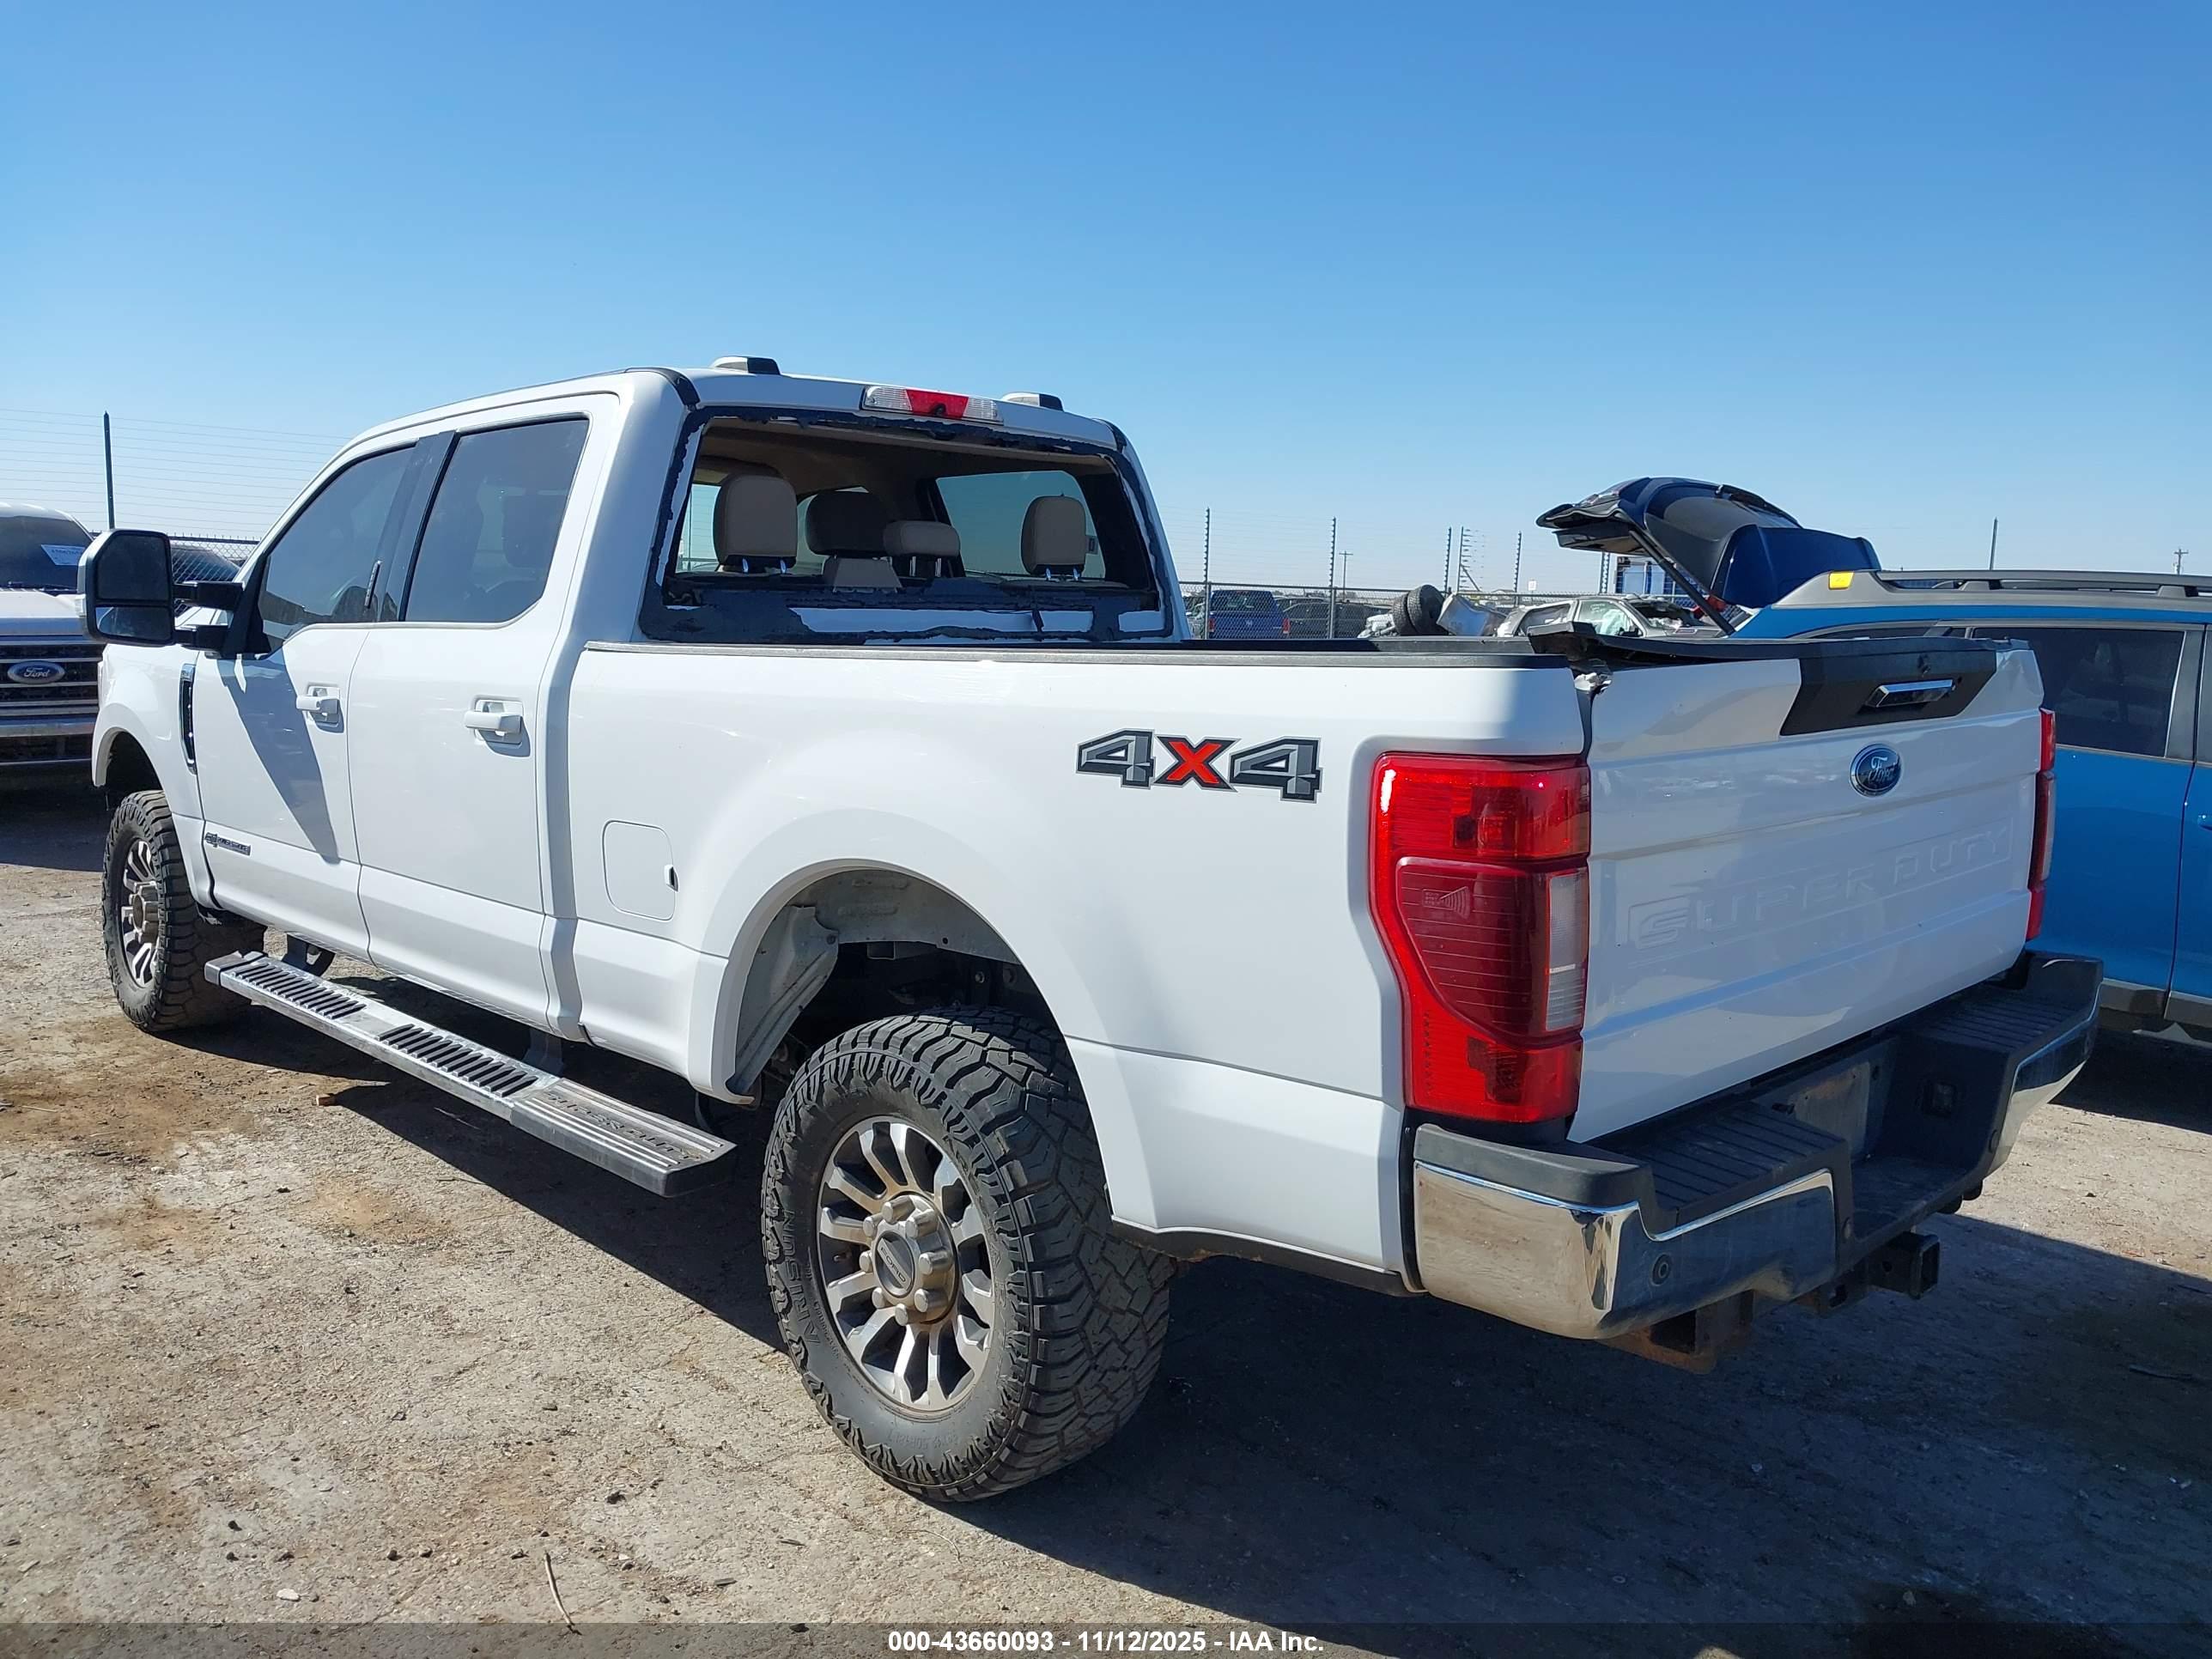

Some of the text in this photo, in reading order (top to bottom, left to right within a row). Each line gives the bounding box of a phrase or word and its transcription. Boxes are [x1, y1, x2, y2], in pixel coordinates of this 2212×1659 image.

[23, 665, 52, 678] Ford
[1635, 825, 2008, 951] SUPER DUTY
[782, 1209, 821, 1345] ARISUN
[880, 1247, 907, 1283] FORD
